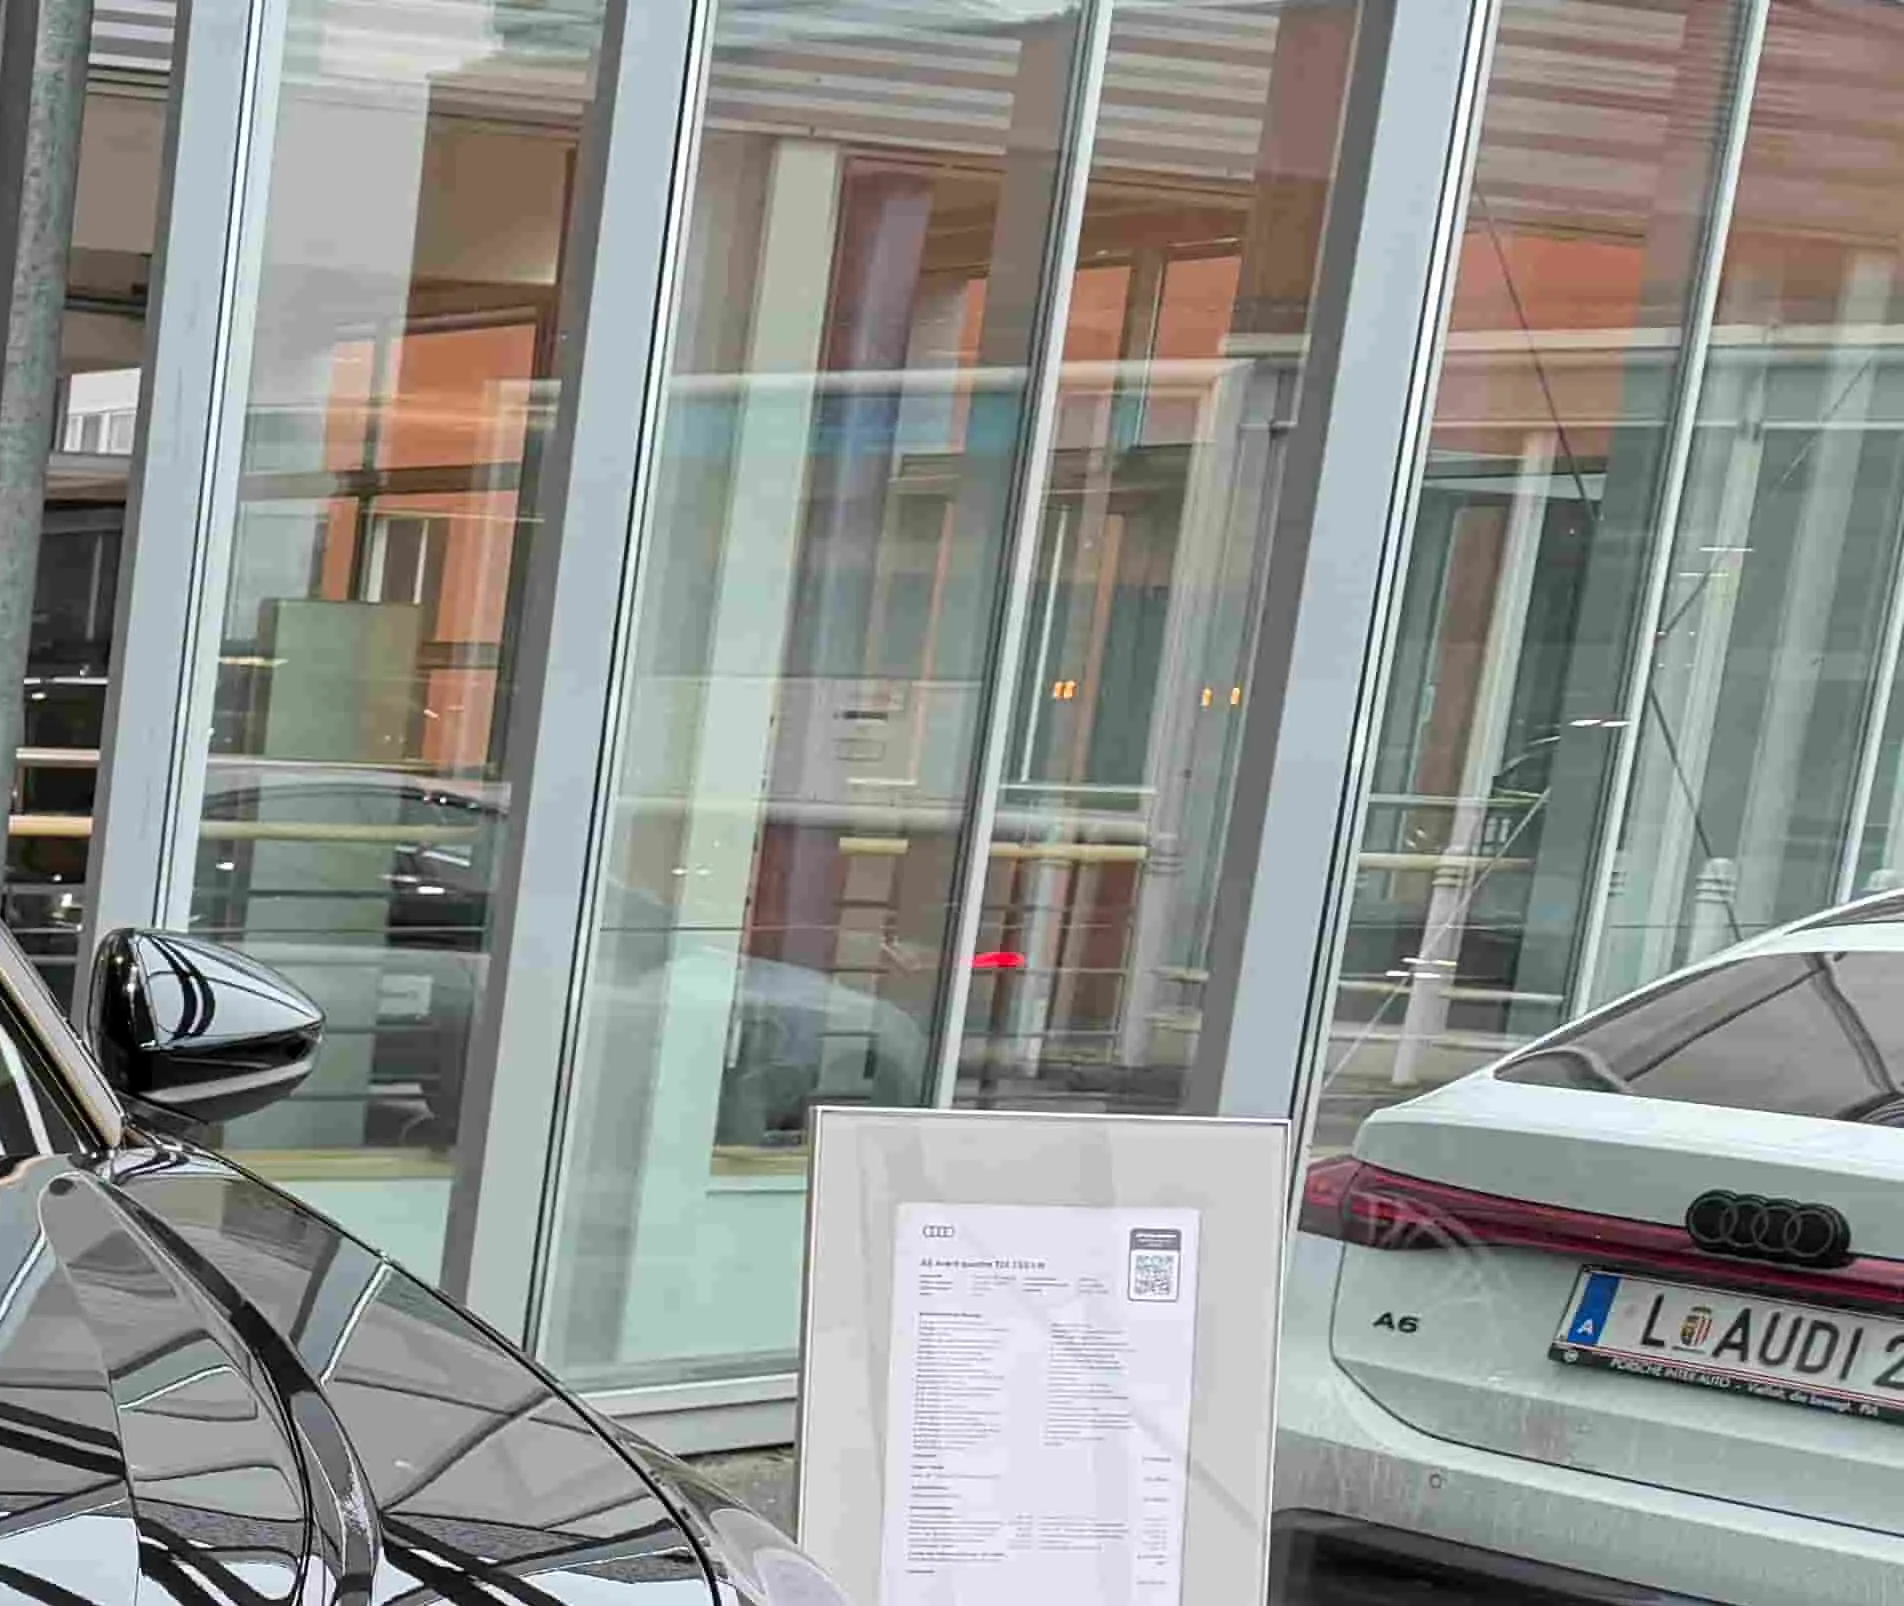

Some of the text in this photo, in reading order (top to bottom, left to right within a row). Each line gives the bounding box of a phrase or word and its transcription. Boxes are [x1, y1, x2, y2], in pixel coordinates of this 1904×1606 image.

[1372, 1311, 1421, 1334] A6
[1576, 1319, 1594, 1336] A
[1641, 1293, 1666, 1347] L
[1711, 1306, 1865, 1381] AUDI
[1698, 1372, 1731, 1389] AUTO
